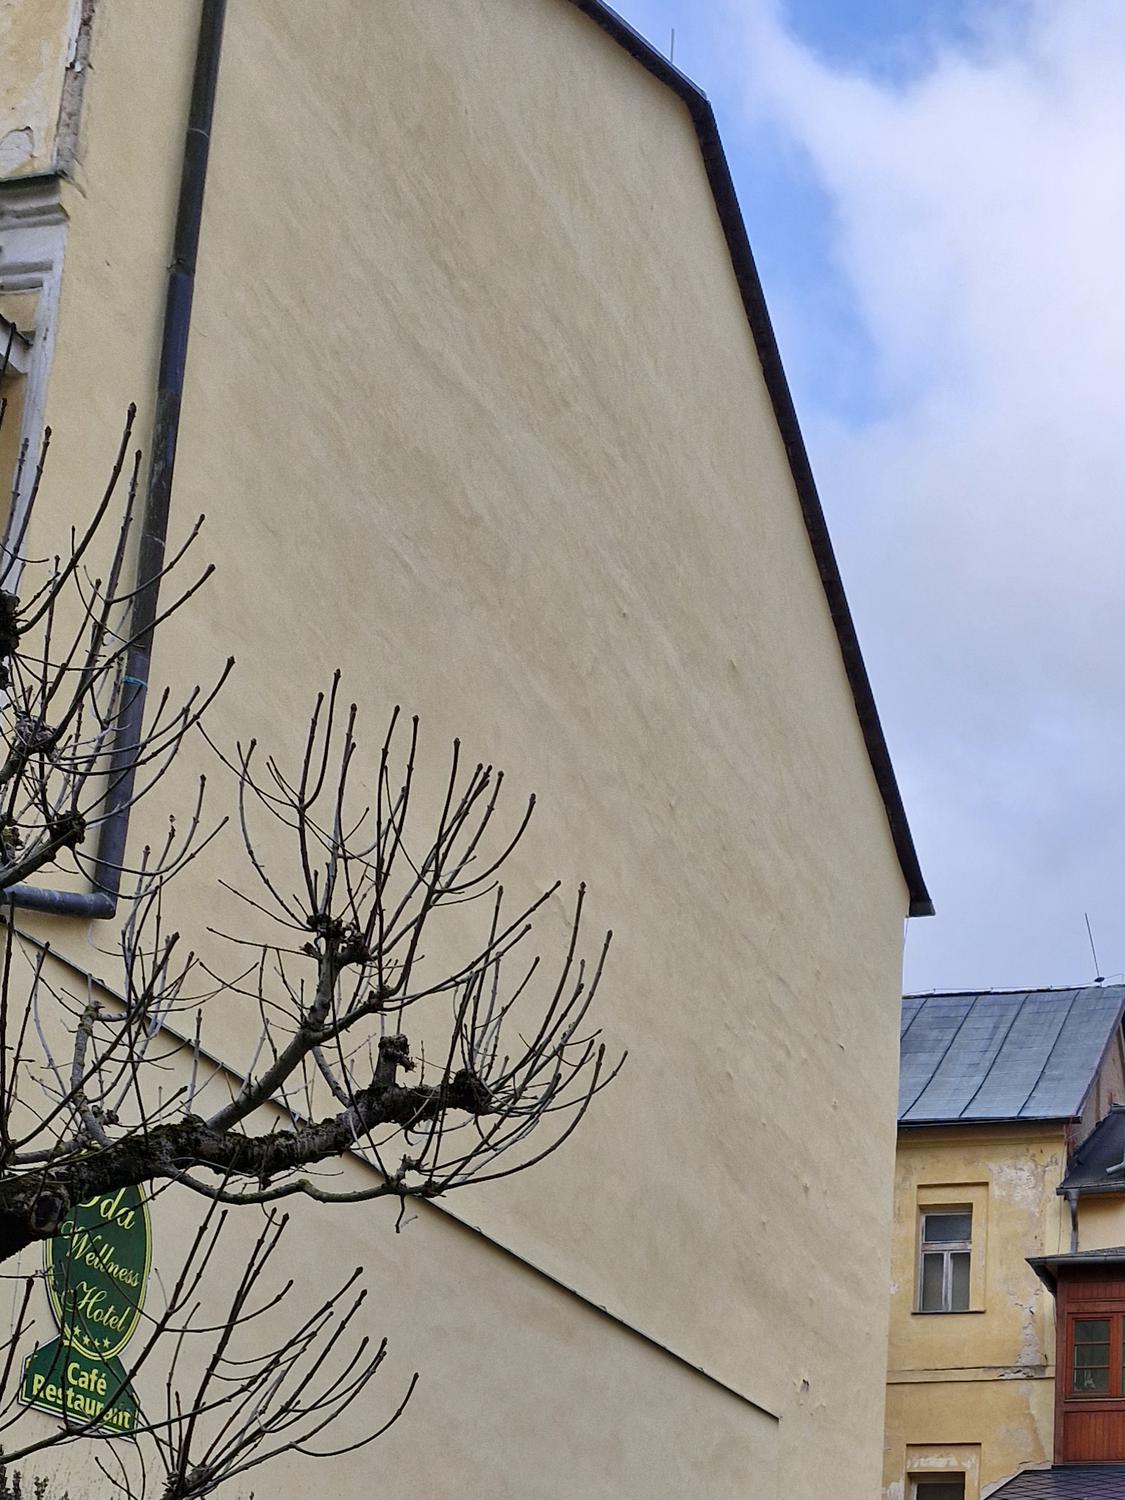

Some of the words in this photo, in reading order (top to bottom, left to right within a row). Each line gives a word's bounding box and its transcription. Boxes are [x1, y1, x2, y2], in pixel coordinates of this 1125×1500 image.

[78, 1187, 135, 1229] da
[61, 1221, 140, 1287] Wellness
[61, 1281, 131, 1332] Hotel
[67, 1362, 107, 1396] Café
